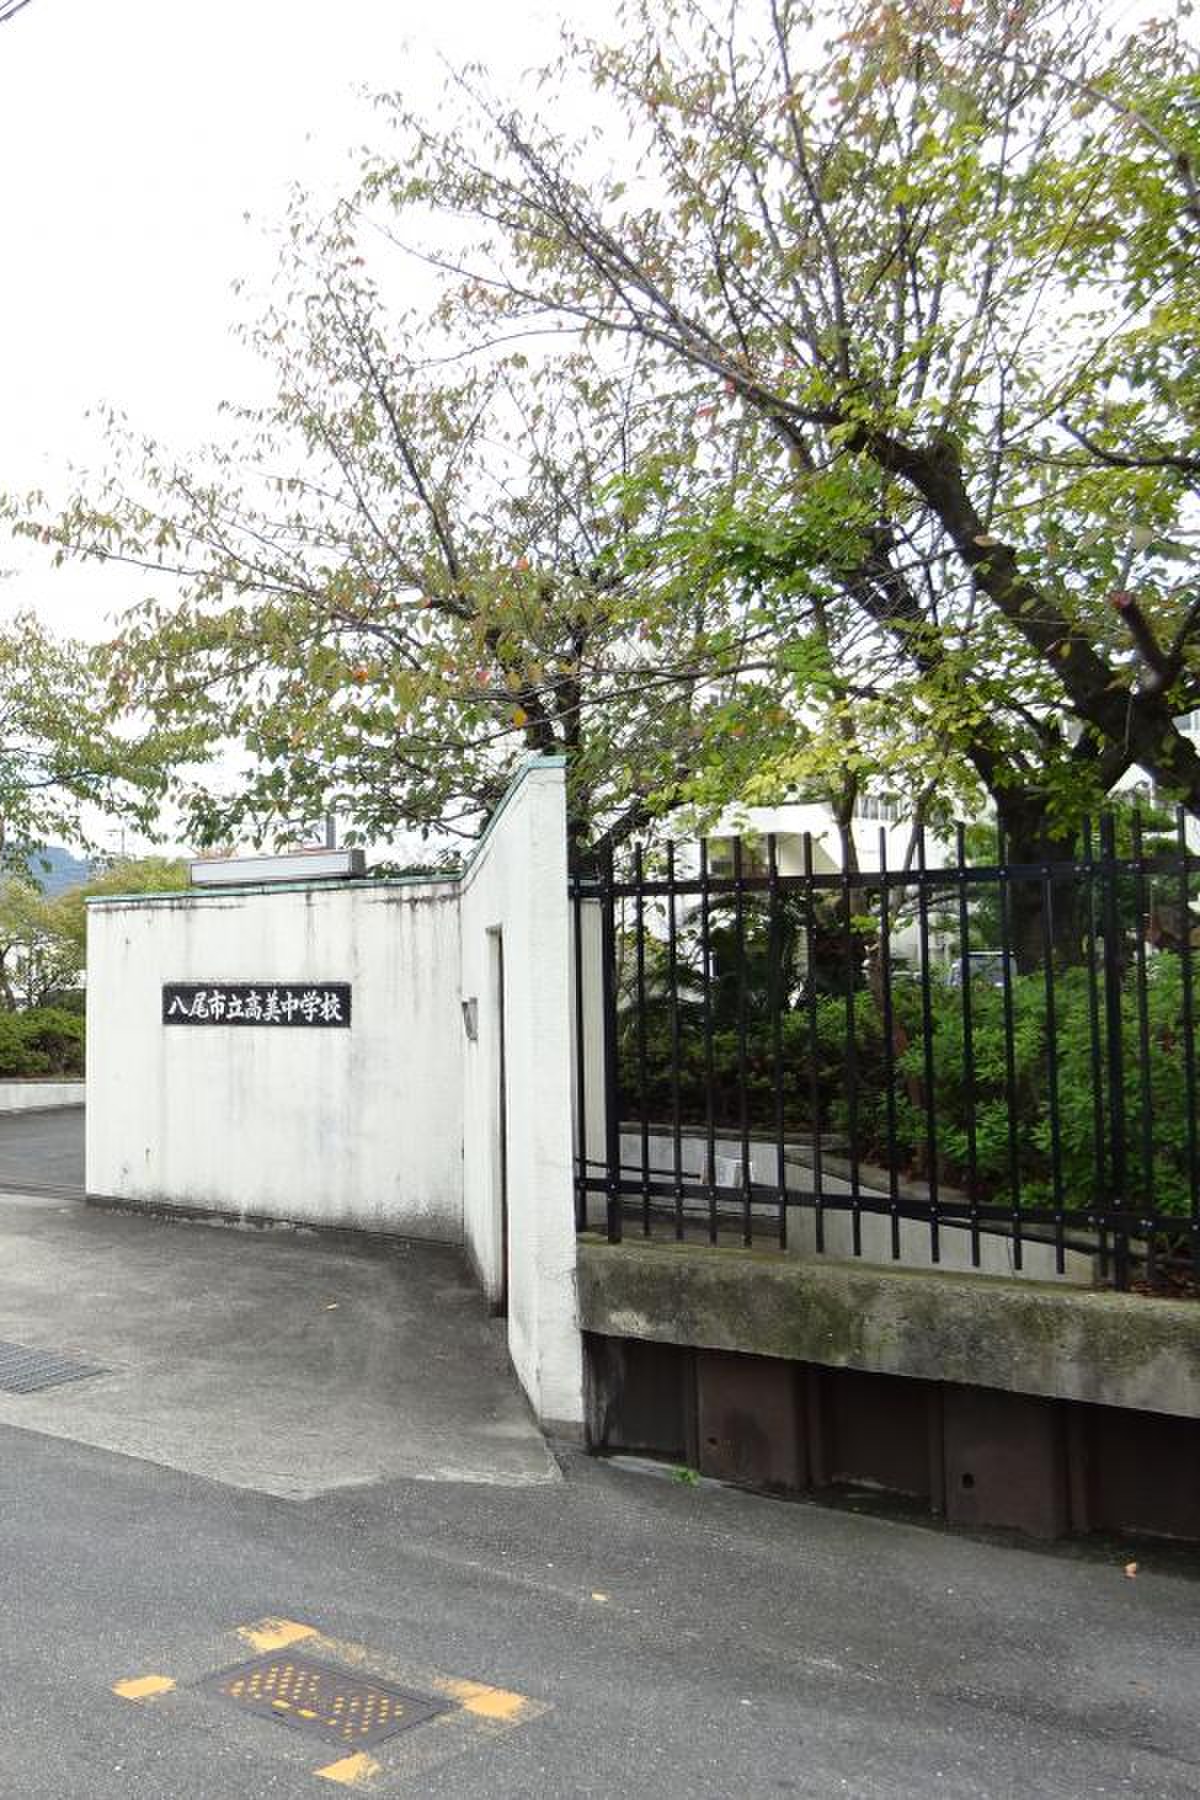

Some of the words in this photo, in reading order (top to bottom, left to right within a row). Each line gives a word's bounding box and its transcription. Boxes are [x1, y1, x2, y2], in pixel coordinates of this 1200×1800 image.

[167, 989, 343, 1022] 八尾市立高美中学校
